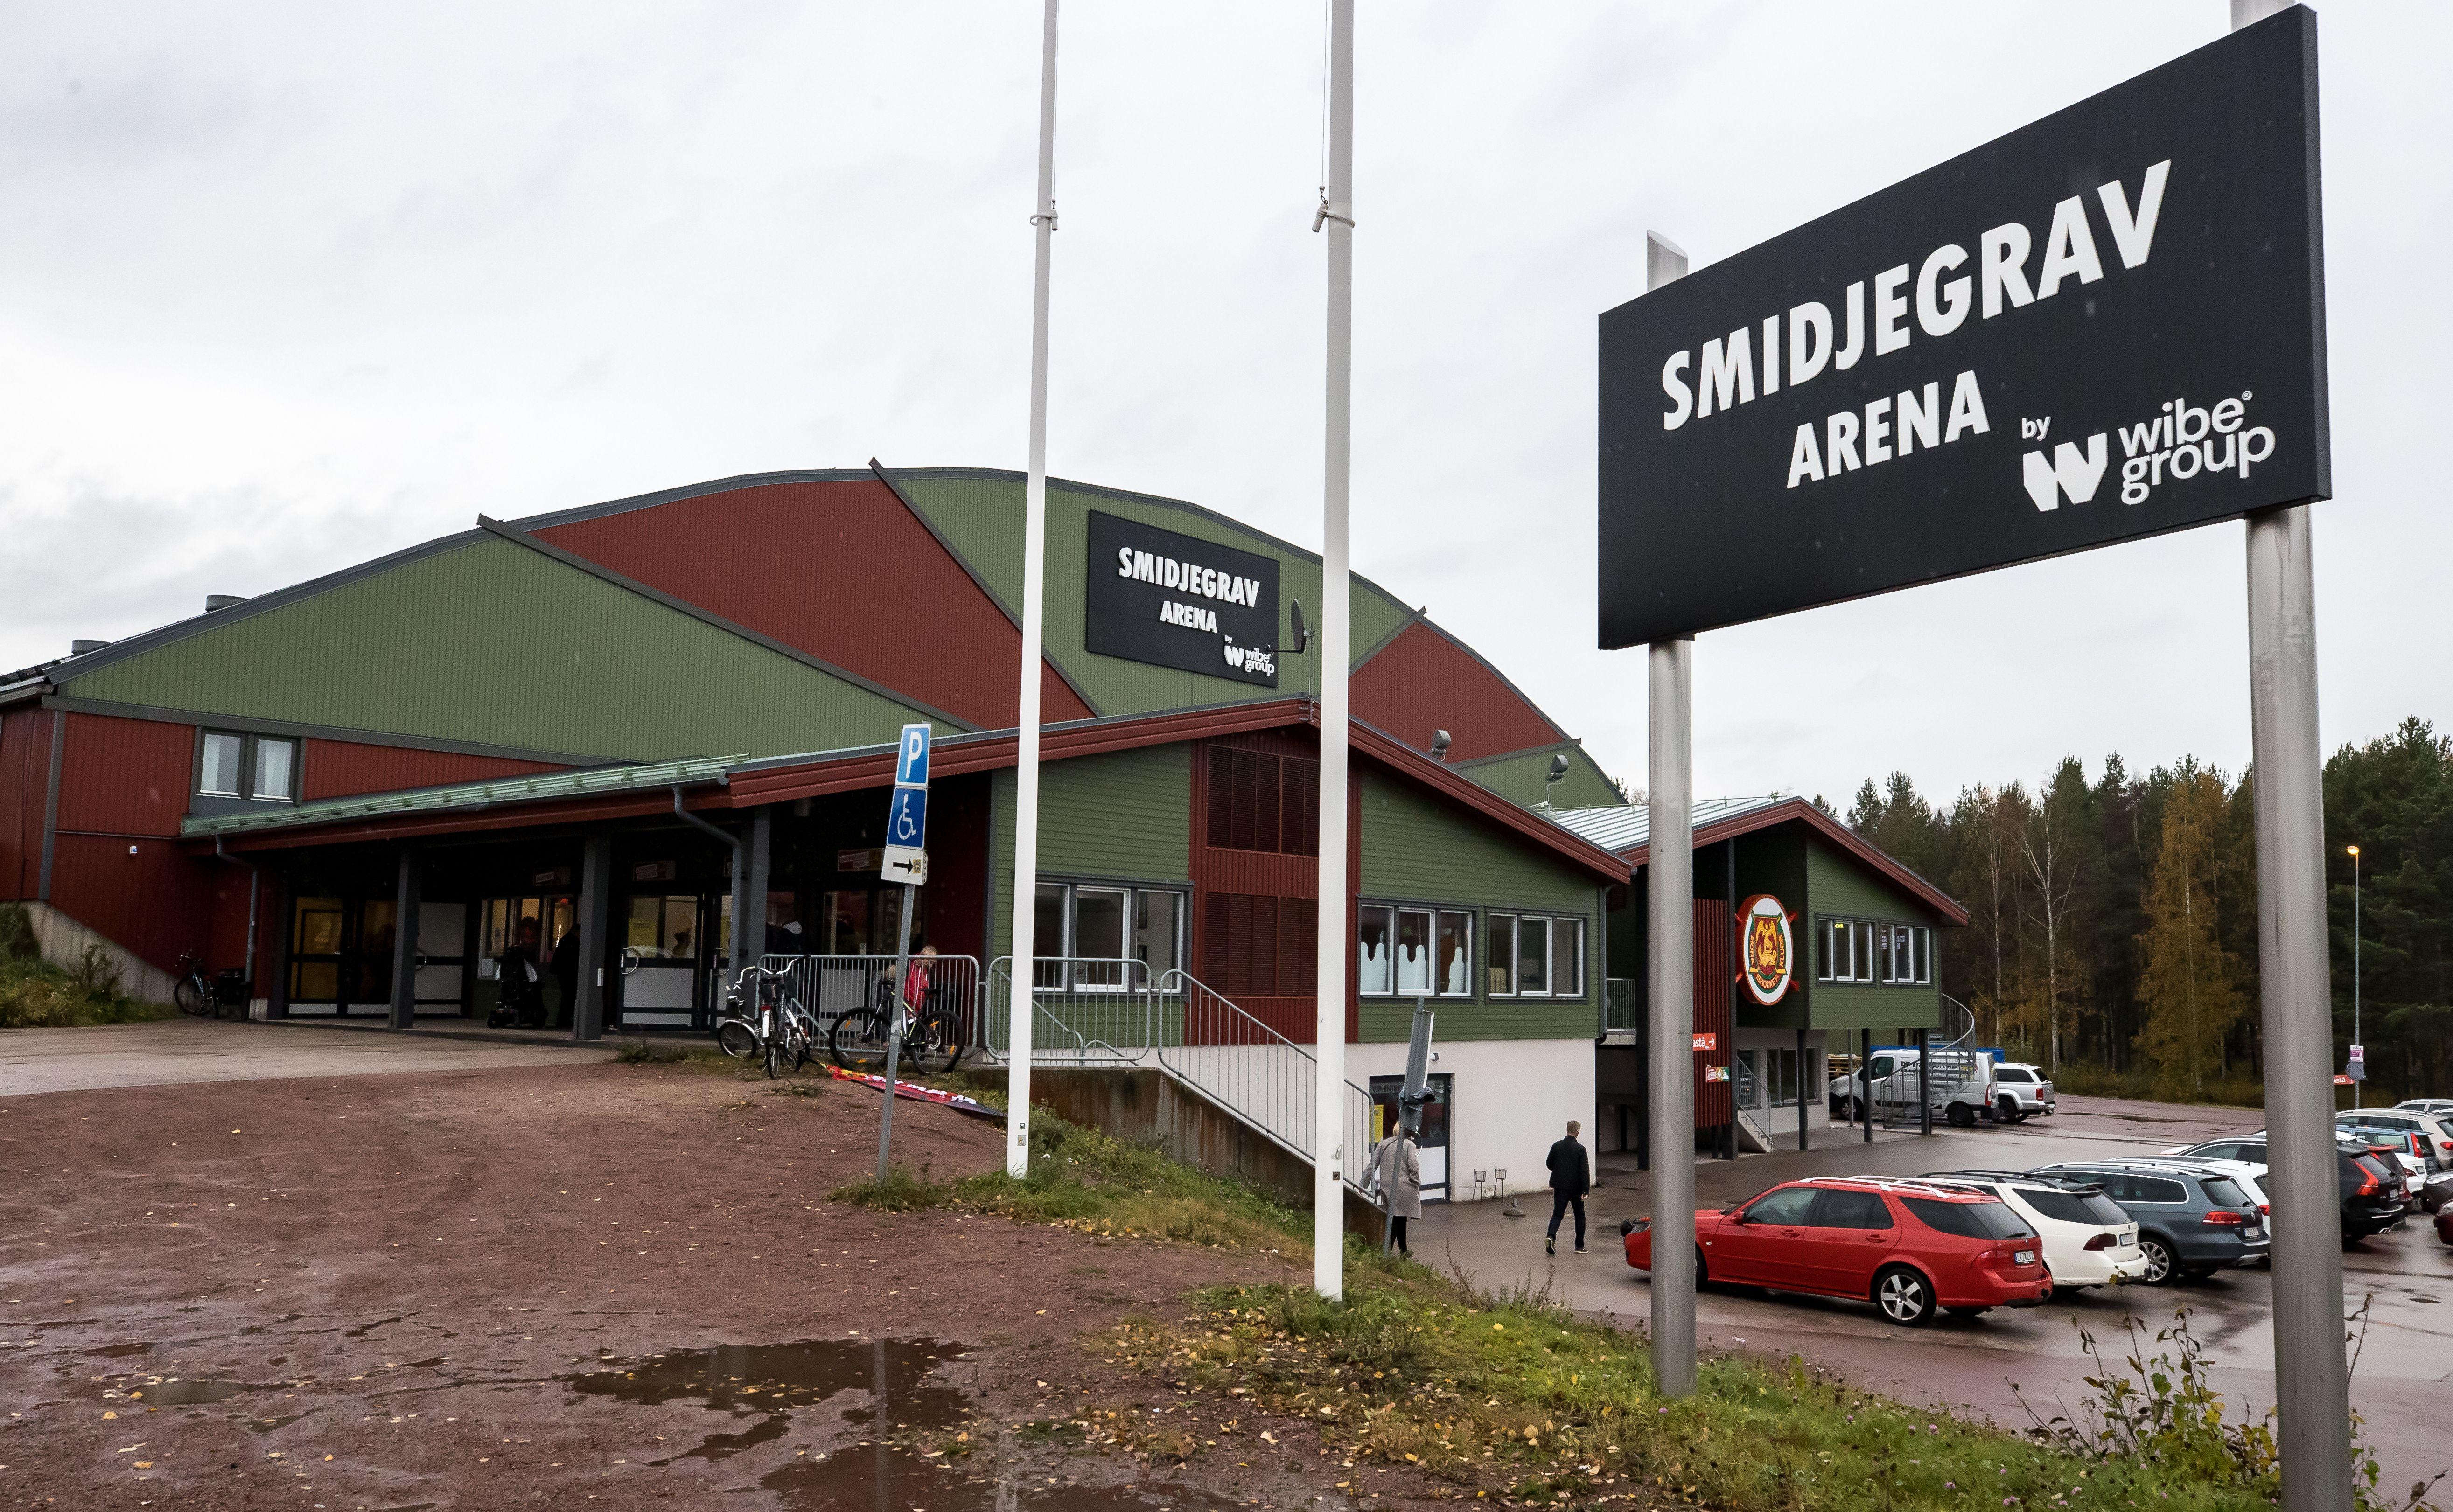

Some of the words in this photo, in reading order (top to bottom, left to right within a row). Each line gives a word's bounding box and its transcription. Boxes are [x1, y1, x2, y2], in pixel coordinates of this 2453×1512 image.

[1662, 159, 2171, 431] SMIDJEGRAV
[1786, 369, 1990, 489] ARENA
[2022, 416, 2051, 441] by
[2118, 398, 2245, 457] wibe
[2121, 426, 2276, 505] group
[1119, 547, 1260, 607] SMIDJEGRAV
[1160, 600, 1218, 634] ARENA
[1224, 634, 1233, 644] by
[1244, 659, 1275, 676] group
[1245, 648, 1271, 663] wibe
[905, 731, 923, 779] P
